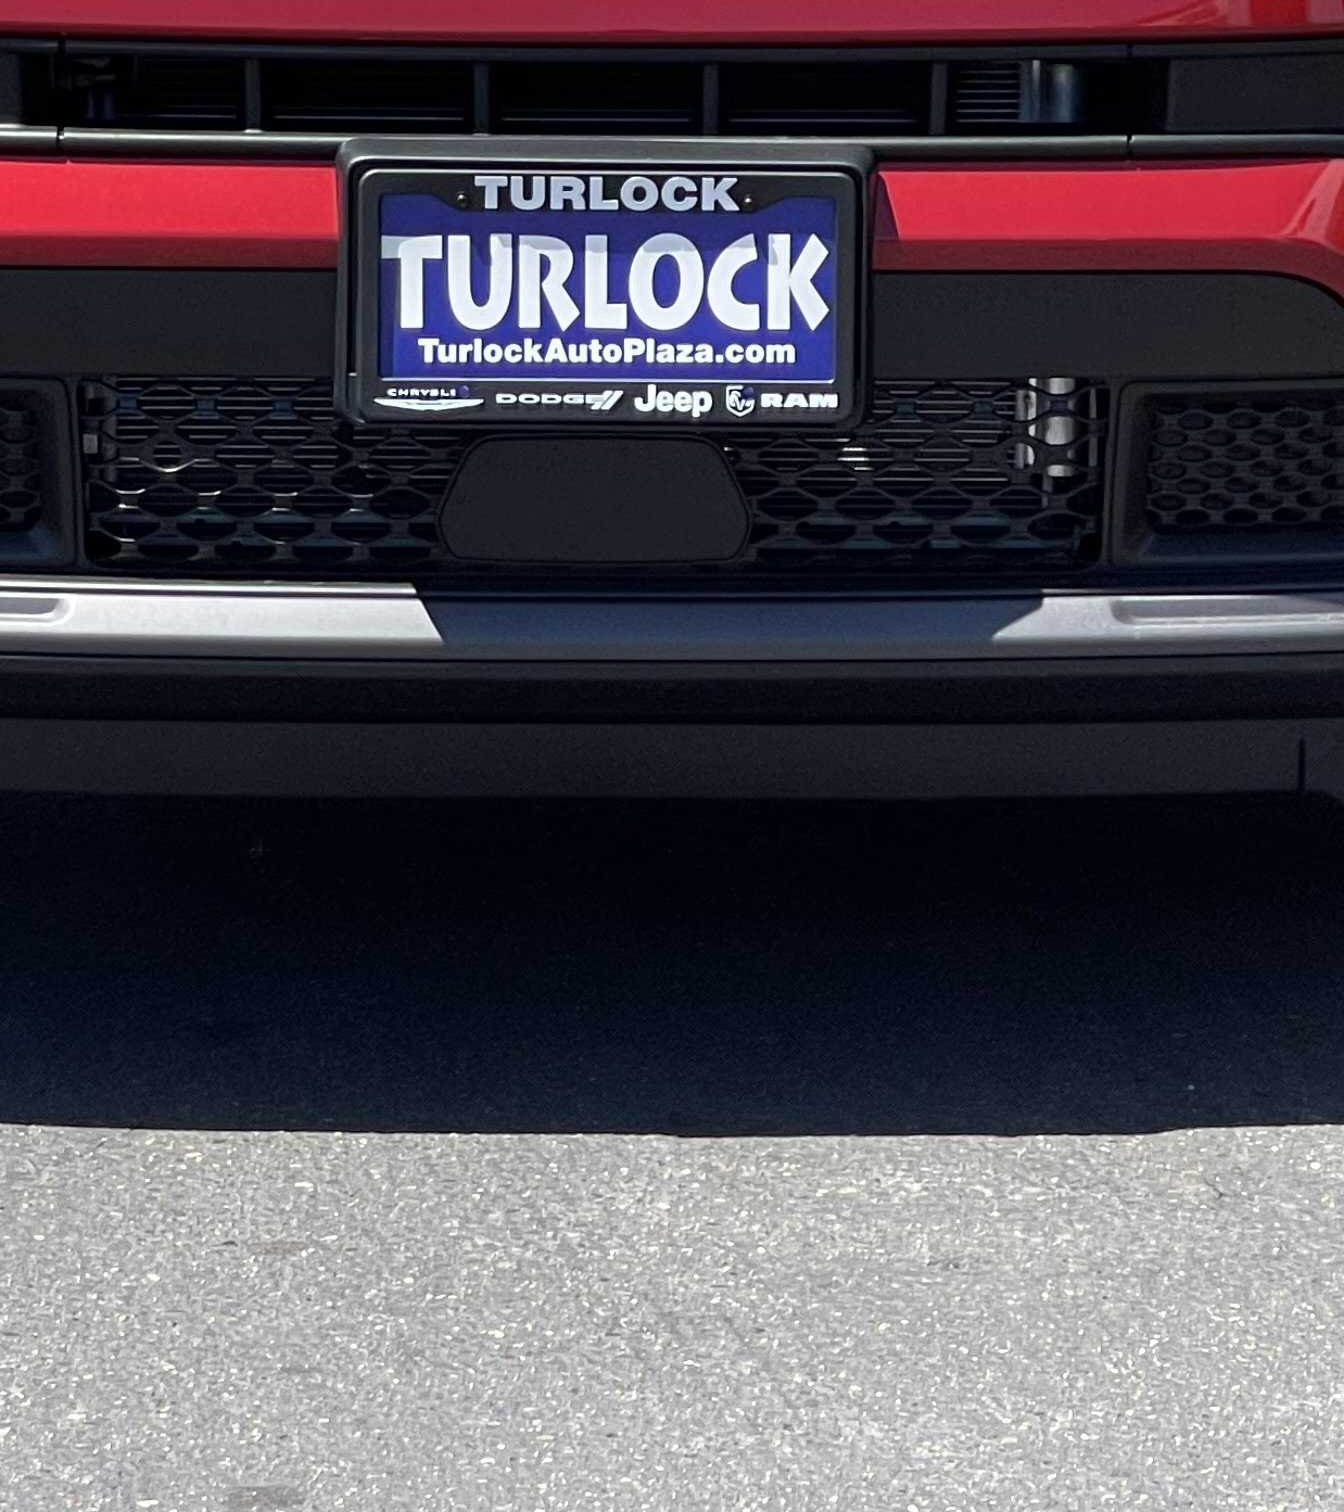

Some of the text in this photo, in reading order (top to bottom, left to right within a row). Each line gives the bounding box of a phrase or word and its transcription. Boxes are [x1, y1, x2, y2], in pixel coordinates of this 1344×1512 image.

[474, 175, 740, 212] TURLOCK
[381, 232, 830, 332] TURLOCK
[417, 337, 796, 364] TurlockAutoPlaza.com
[495, 392, 605, 405] DODGE
[633, 383, 713, 418] Jeep
[760, 392, 839, 408] RAM
